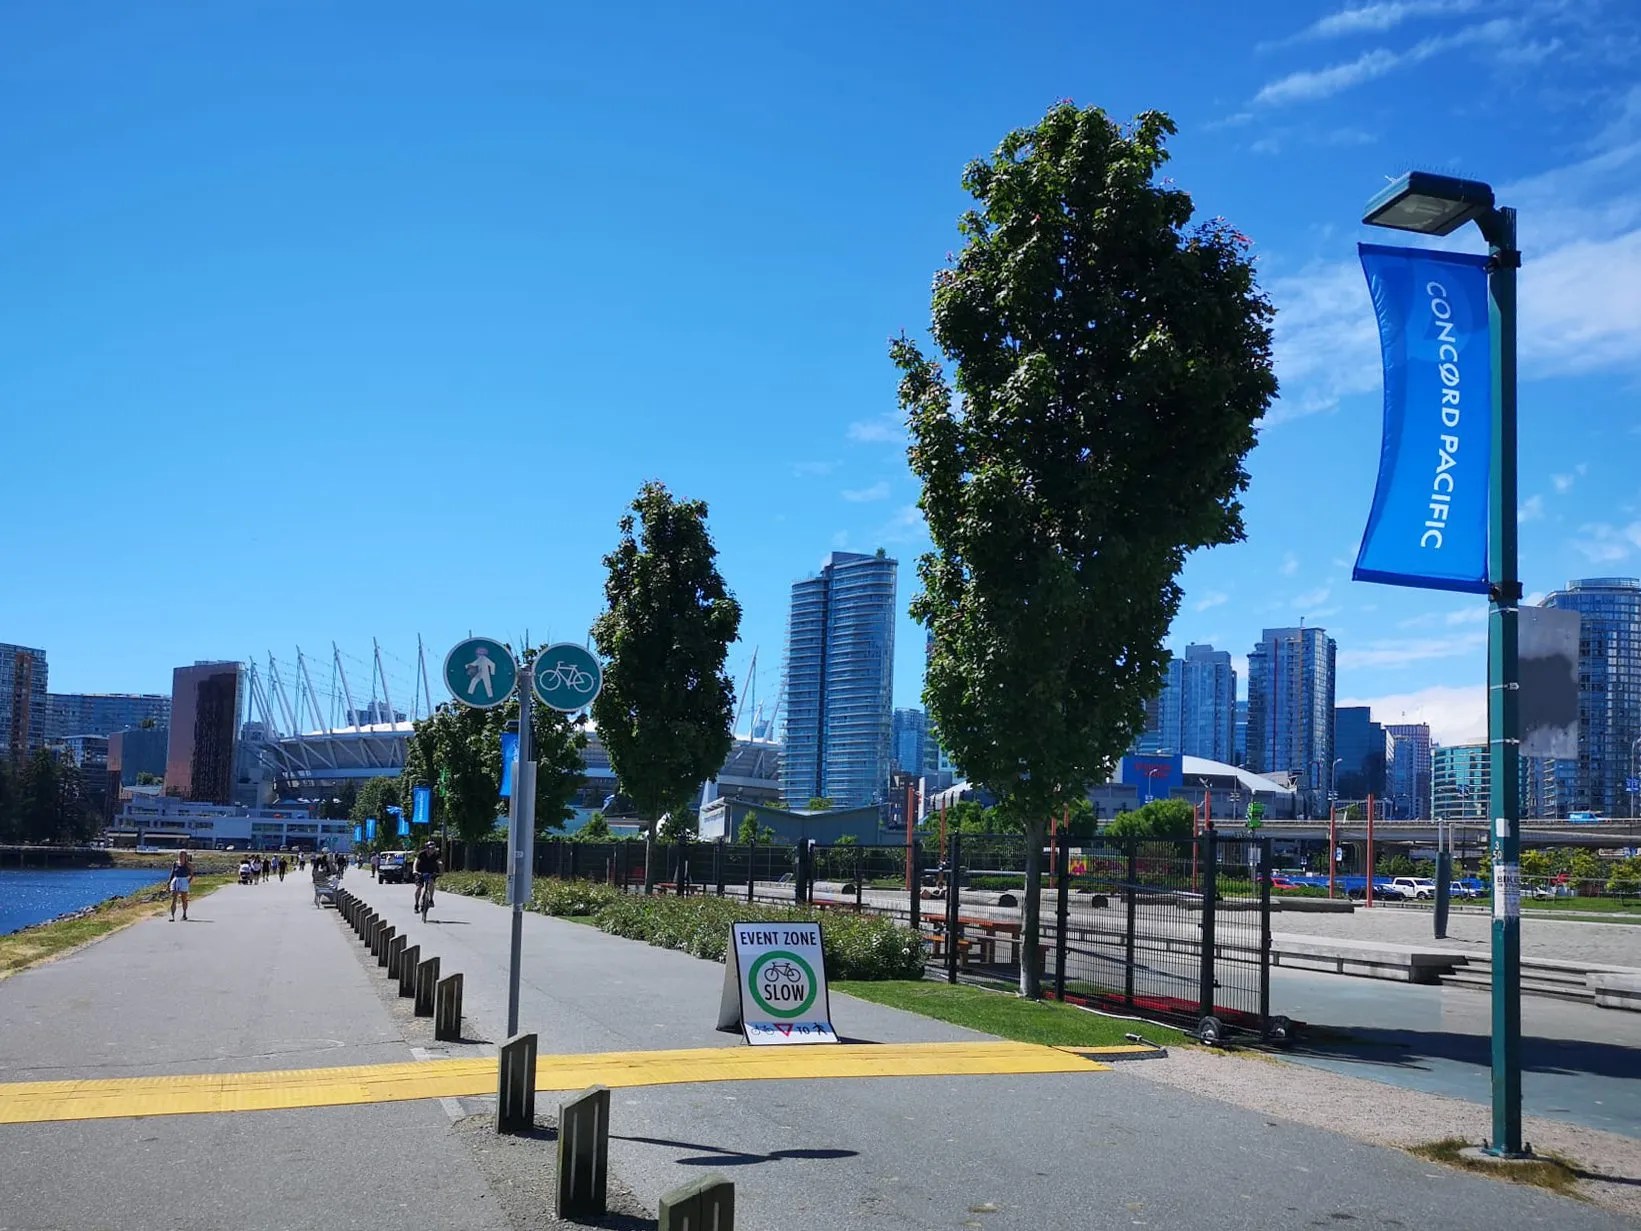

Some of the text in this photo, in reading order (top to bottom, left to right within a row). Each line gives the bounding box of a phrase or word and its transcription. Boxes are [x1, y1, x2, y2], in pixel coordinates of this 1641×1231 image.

[1420, 434, 1459, 549] PACIFIC
[740, 932, 817, 945] EVENT ZONE
[764, 984, 804, 1001] SLOW
